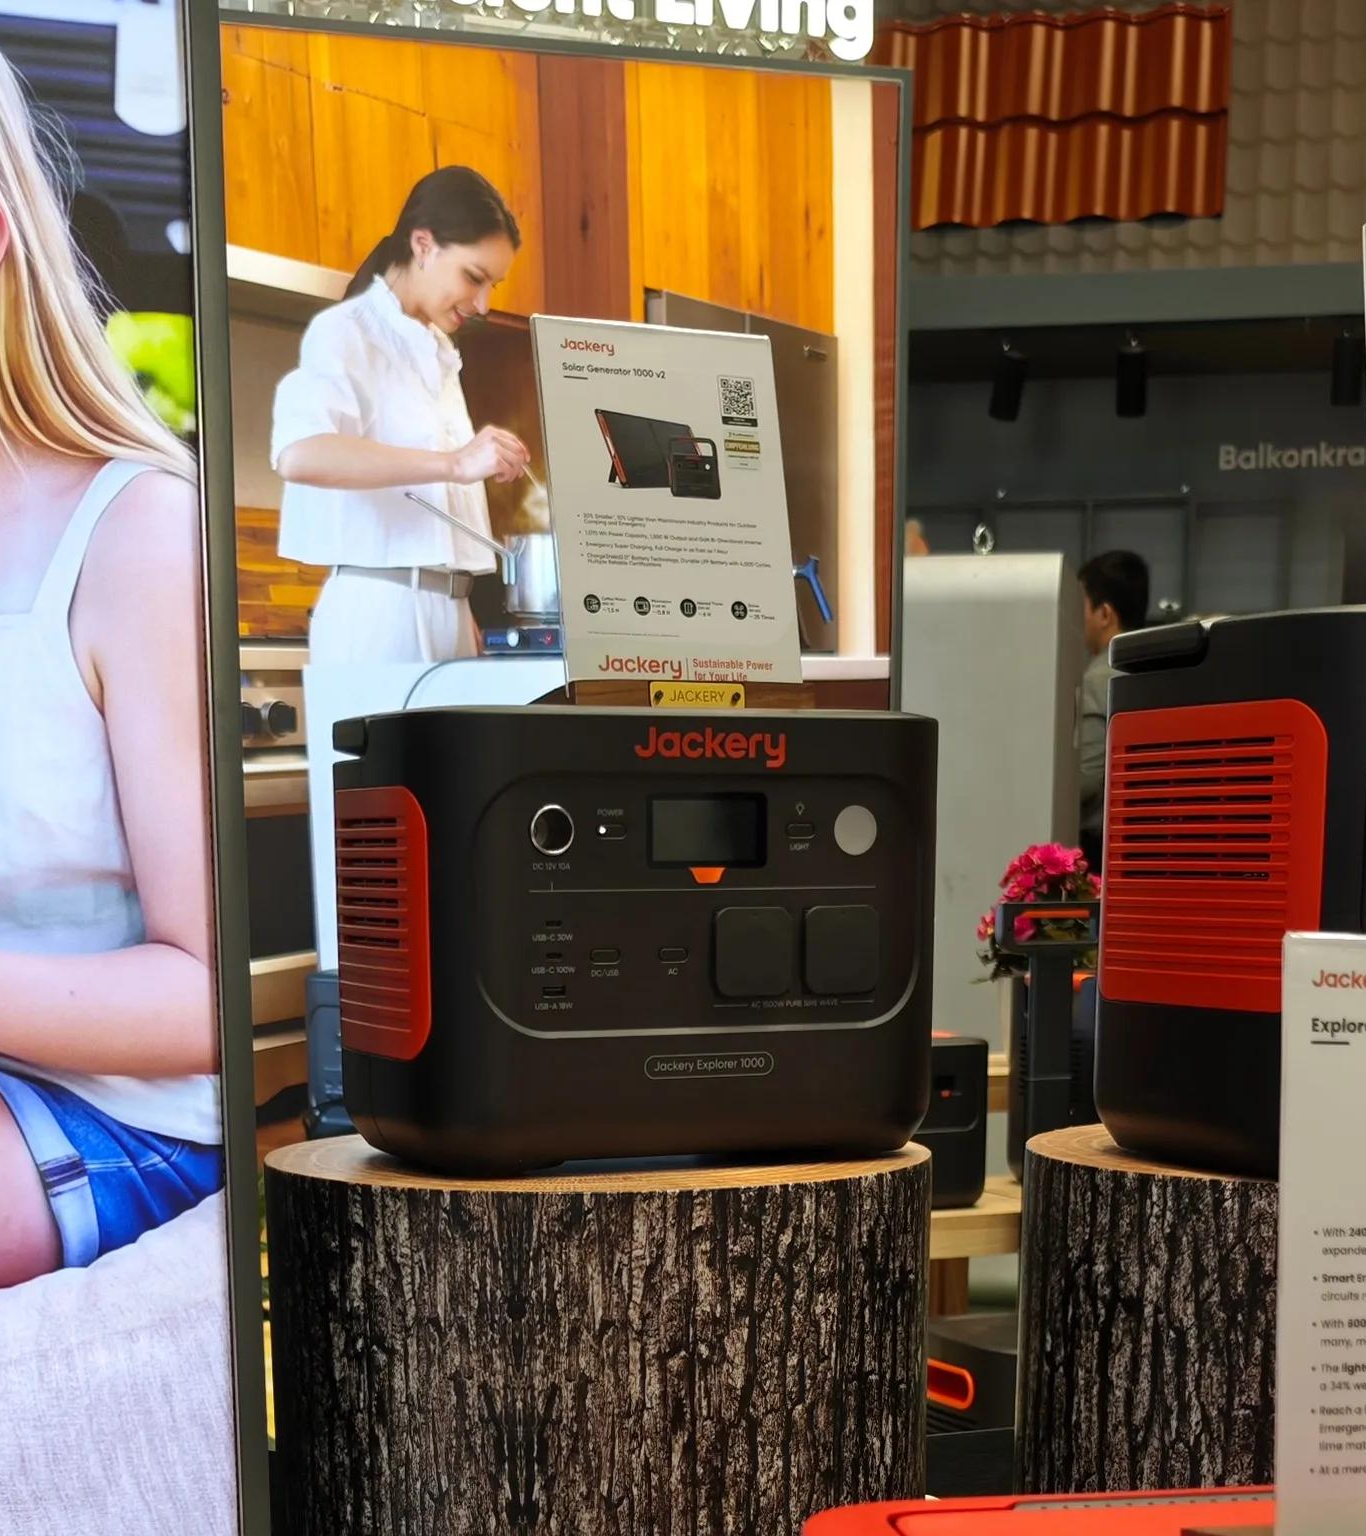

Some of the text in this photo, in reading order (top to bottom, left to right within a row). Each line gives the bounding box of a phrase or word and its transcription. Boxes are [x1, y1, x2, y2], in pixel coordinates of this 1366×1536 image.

[561, 338, 615, 356] Jackery
[562, 362, 666, 379] Solar Generator 1000 v2
[598, 655, 682, 679] Jackery
[693, 658, 773, 671] Sustainable Power
[670, 690, 725, 702] JACKERY
[634, 727, 786, 768] Jackery
[654, 1057, 765, 1072] Jackery Explorer 1000
[1322, 1228, 1346, 1237] With
[1322, 1274, 1354, 1283] Smart
